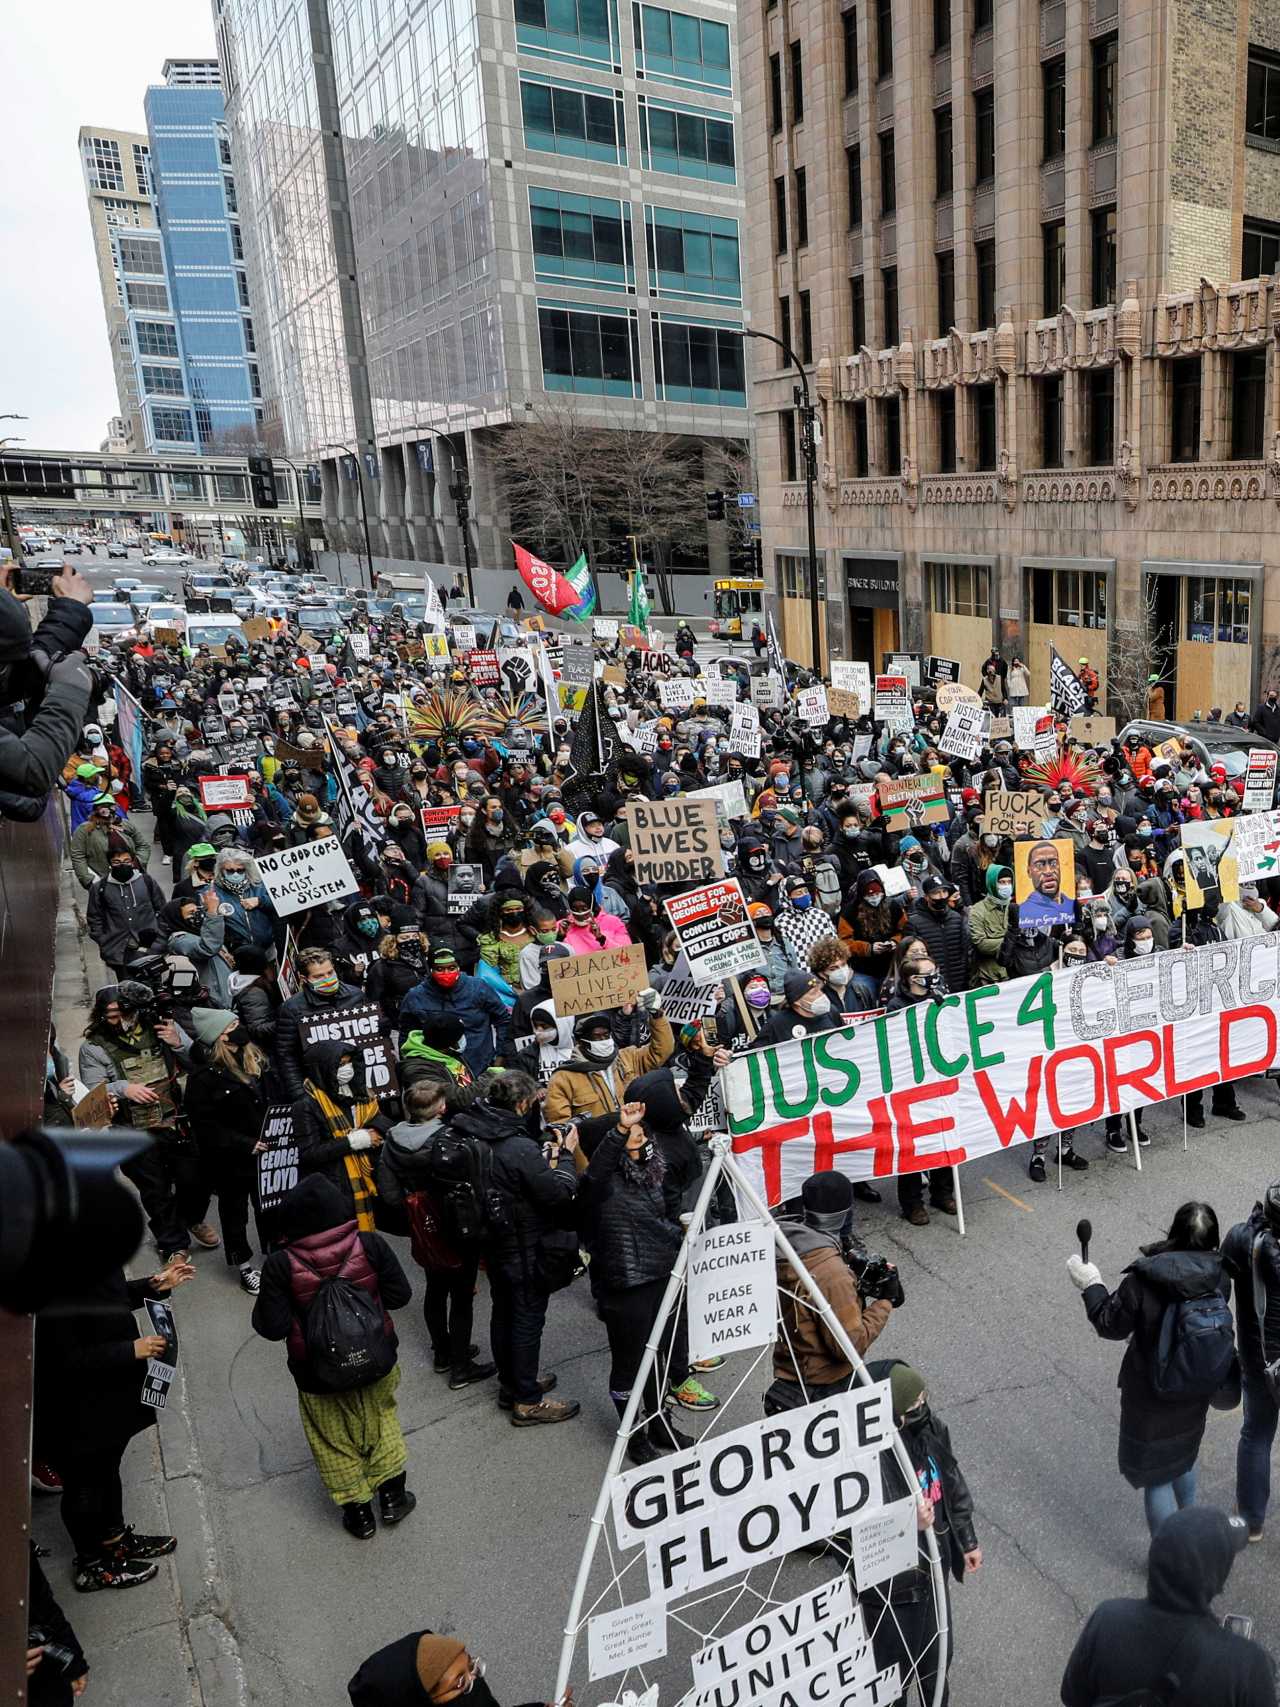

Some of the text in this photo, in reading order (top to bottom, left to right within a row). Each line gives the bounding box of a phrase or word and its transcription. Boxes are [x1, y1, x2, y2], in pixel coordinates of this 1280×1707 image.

[472, 665, 498, 674] GEORGE
[642, 652, 671, 677] ACAB
[1052, 656, 1087, 704] BLACK
[666, 689, 685, 697] LIVES
[735, 703, 758, 718] JUSTICE
[800, 705, 826, 717] DAUNTE
[808, 715, 828, 725] RIGHT
[955, 703, 983, 722] JUSTICE
[743, 719, 752, 728] FOR
[961, 720, 971, 729] FOR
[731, 728, 758, 744] DAUNTE
[942, 738, 973, 755] WRIGHT
[945, 726, 976, 746] DAUNTE
[730, 741, 757, 755] WRIGHT
[887, 793, 903, 803] REST
[989, 792, 1042, 818] FUCK
[634, 803, 704, 829] BLUE
[635, 827, 709, 855] LIVES
[258, 839, 339, 875] NO GOOD COPS
[289, 865, 315, 879] IN A
[636, 856, 717, 882] MURDER
[269, 876, 313, 900] RACIST
[297, 880, 346, 904] SYSTEM
[670, 886, 727, 911] JUSTICE FOR
[672, 891, 739, 922] GEORGE FLOYD
[681, 919, 723, 940] CONVICT
[687, 928, 748, 957] KILLER COPS
[560, 954, 621, 979] BLACK
[708, 949, 761, 973] KEUNG & THAO
[576, 973, 629, 996] LIVES
[663, 979, 718, 1002] DAUNTE
[562, 989, 635, 1017] MATTER
[306, 1014, 380, 1044] JUSTICE
[727, 984, 1005, 1135] JUSTICE
[1016, 971, 1057, 1052] 4
[731, 1077, 967, 1208] THE
[972, 1003, 1279, 1148] WORLD
[277, 1137, 289, 1146] FOR
[261, 1166, 298, 1195] FLOYD
[703, 1231, 752, 1251] PLEASE
[692, 1248, 767, 1276] VACCINATE
[707, 1283, 753, 1304] PLEASE
[703, 1302, 758, 1326] WEAR A
[711, 1323, 752, 1344] MASK
[142, 1389, 166, 1406] FLOYD
[624, 1395, 883, 1531] GEORGE
[657, 1470, 872, 1590] FLOYD
[861, 1535, 896, 1553] TEAR DROP
[862, 1554, 890, 1571] CATCHER
[611, 1611, 644, 1629] Given by
[604, 1639, 626, 1652] Great
